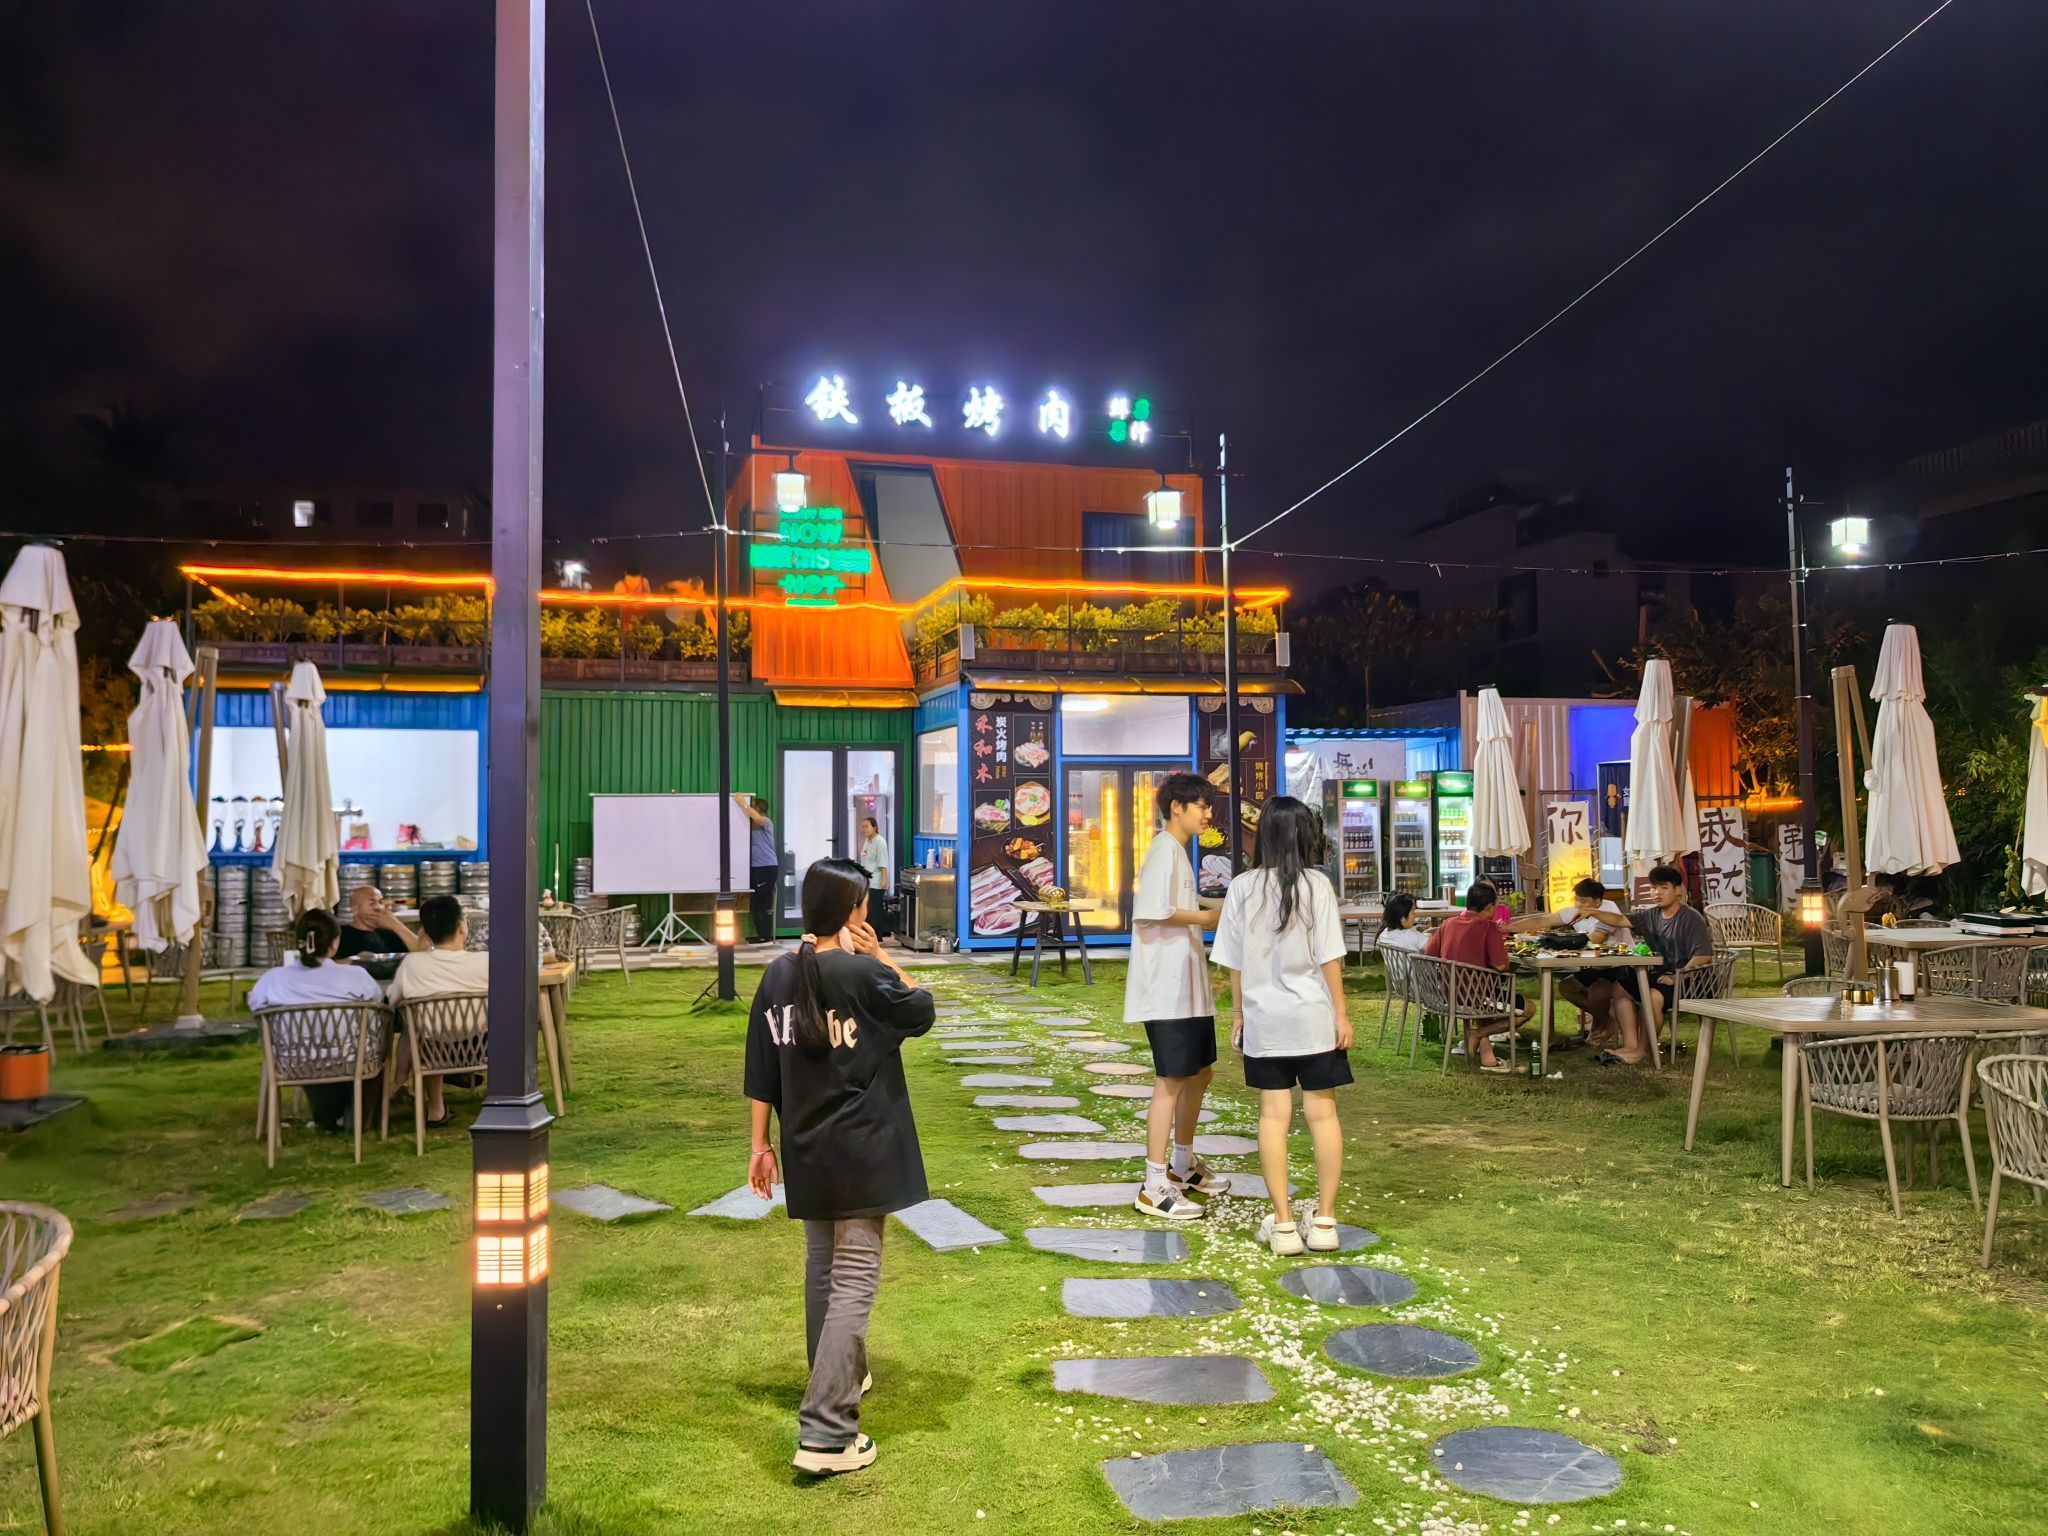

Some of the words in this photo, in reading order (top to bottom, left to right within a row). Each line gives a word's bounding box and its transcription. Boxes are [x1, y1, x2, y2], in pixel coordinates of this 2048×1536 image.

[779, 521, 842, 544] NOW
[996, 716, 1007, 762] 炭火烤肉
